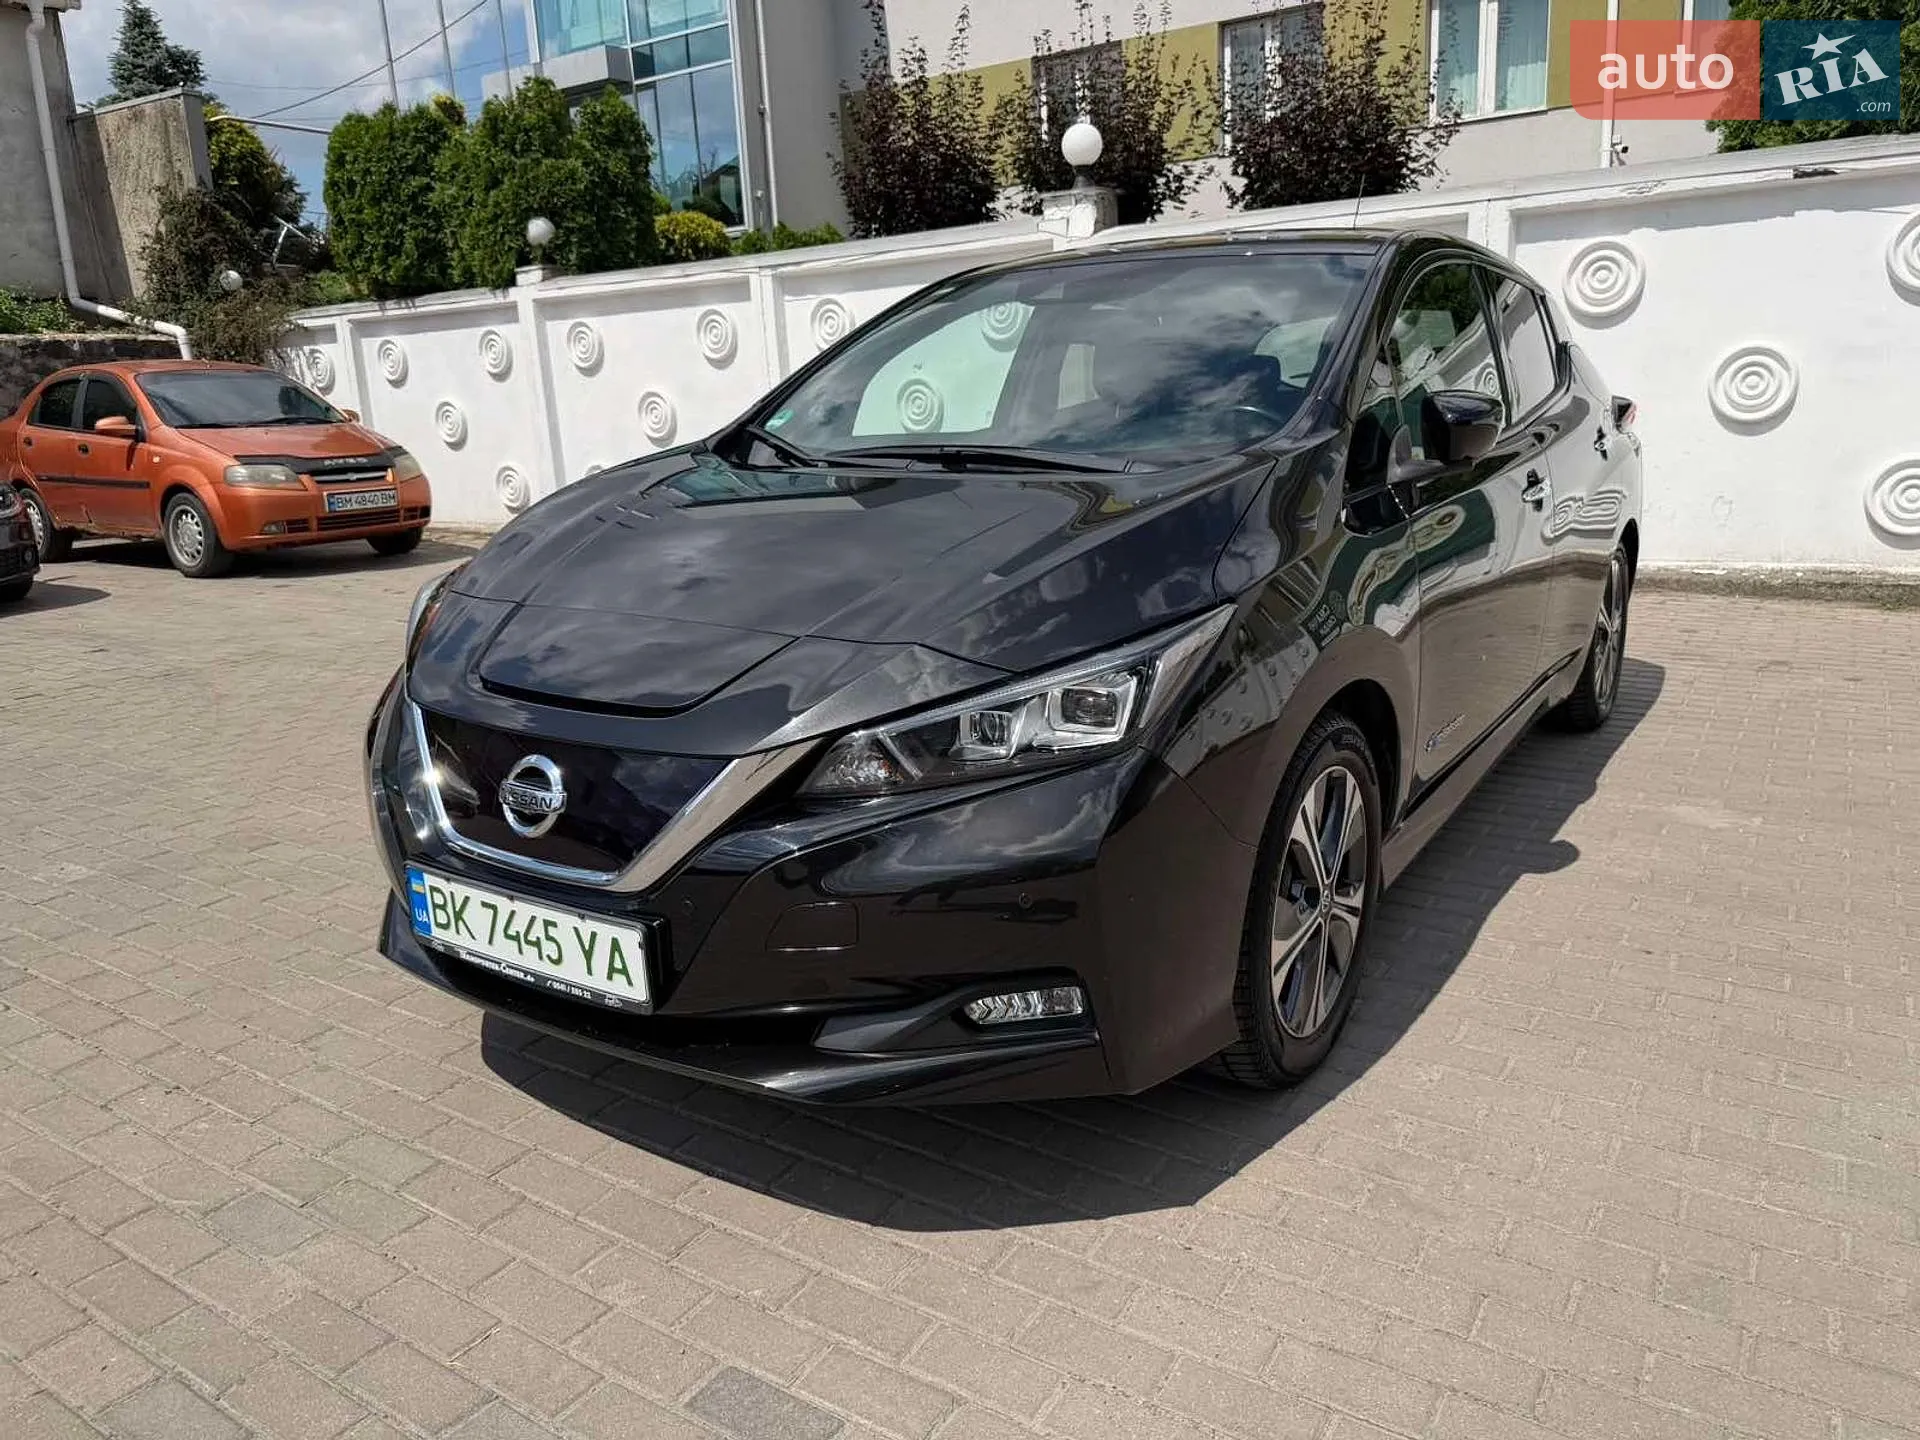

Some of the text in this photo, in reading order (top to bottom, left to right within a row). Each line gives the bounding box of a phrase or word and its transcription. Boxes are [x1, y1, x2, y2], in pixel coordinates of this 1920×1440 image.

[336, 492, 396, 509] BM 4840 BM
[415, 908, 429, 923] UA
[429, 884, 476, 941] BK
[481, 900, 564, 967] 7445
[573, 926, 634, 987] YA
